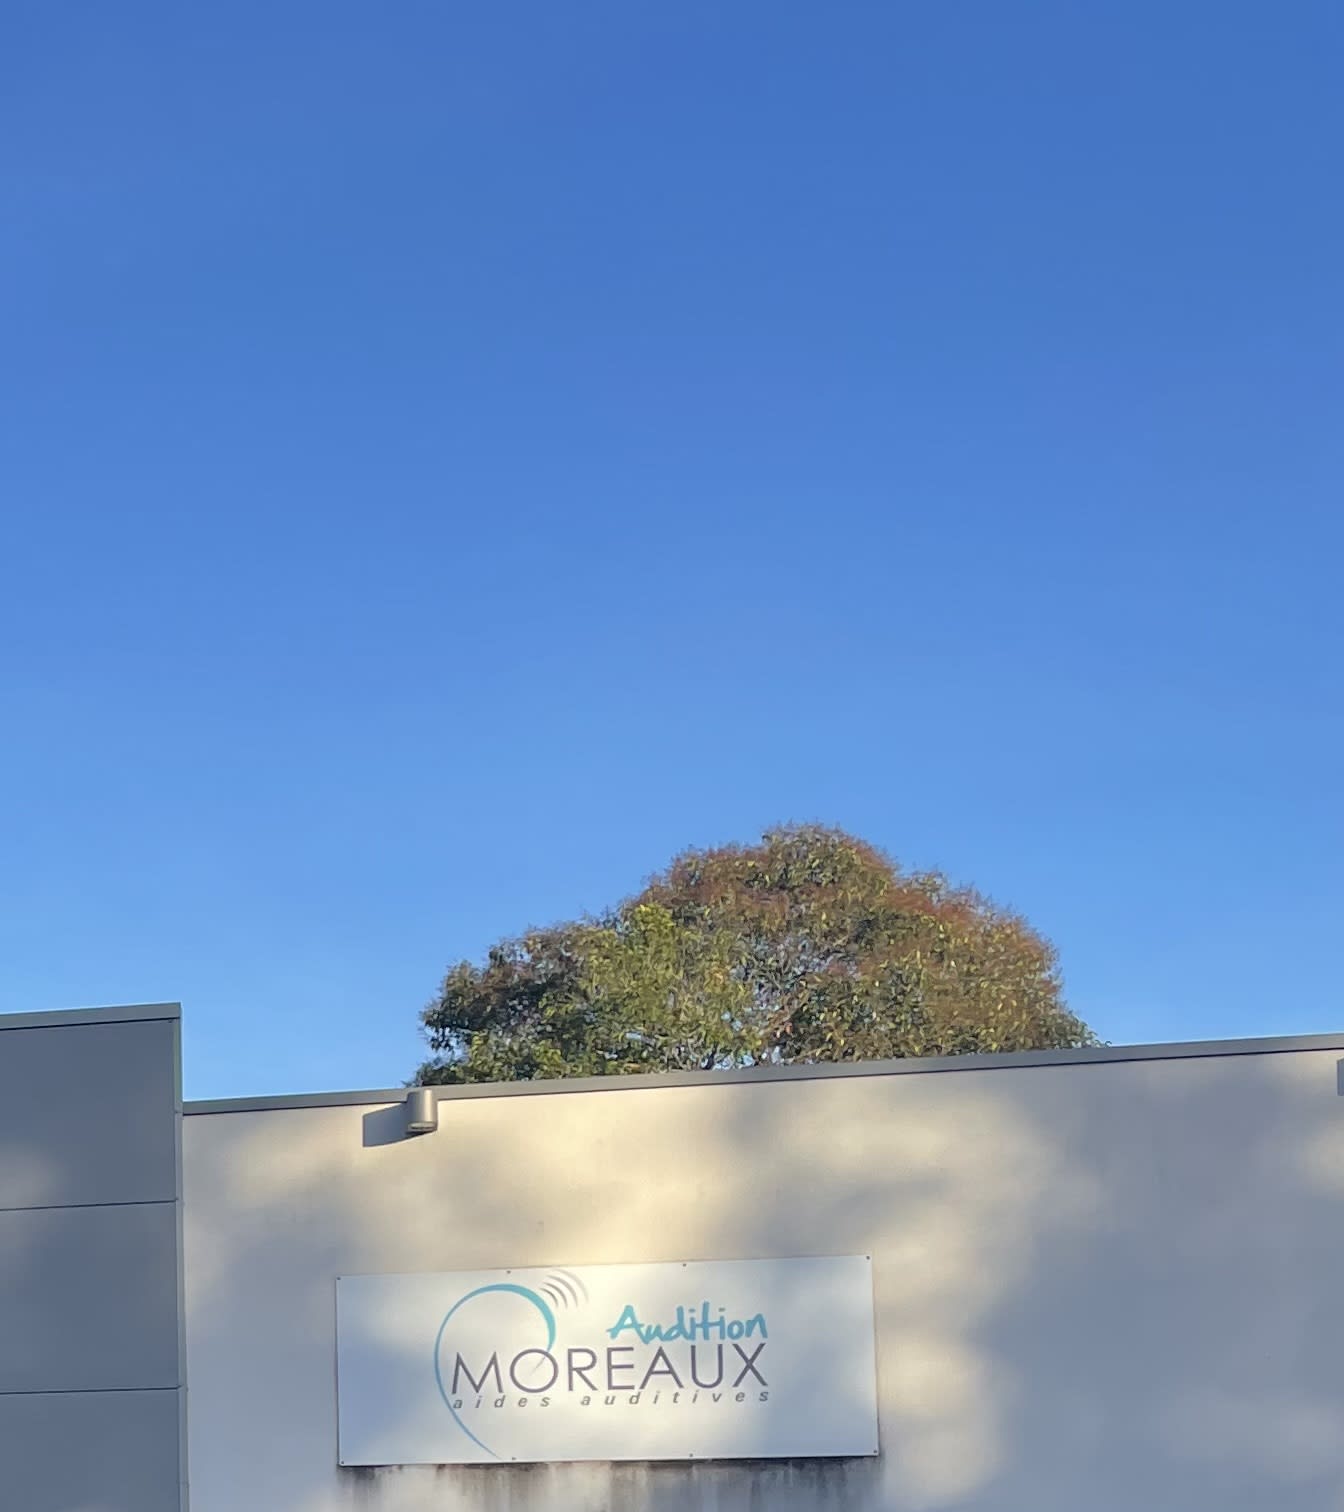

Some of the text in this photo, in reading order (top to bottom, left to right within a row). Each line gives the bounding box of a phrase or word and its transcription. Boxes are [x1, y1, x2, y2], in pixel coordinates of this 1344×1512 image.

[606, 1301, 768, 1344] Audition
[451, 1342, 769, 1395] MOREAUX
[452, 1390, 770, 1410] aides auditives
